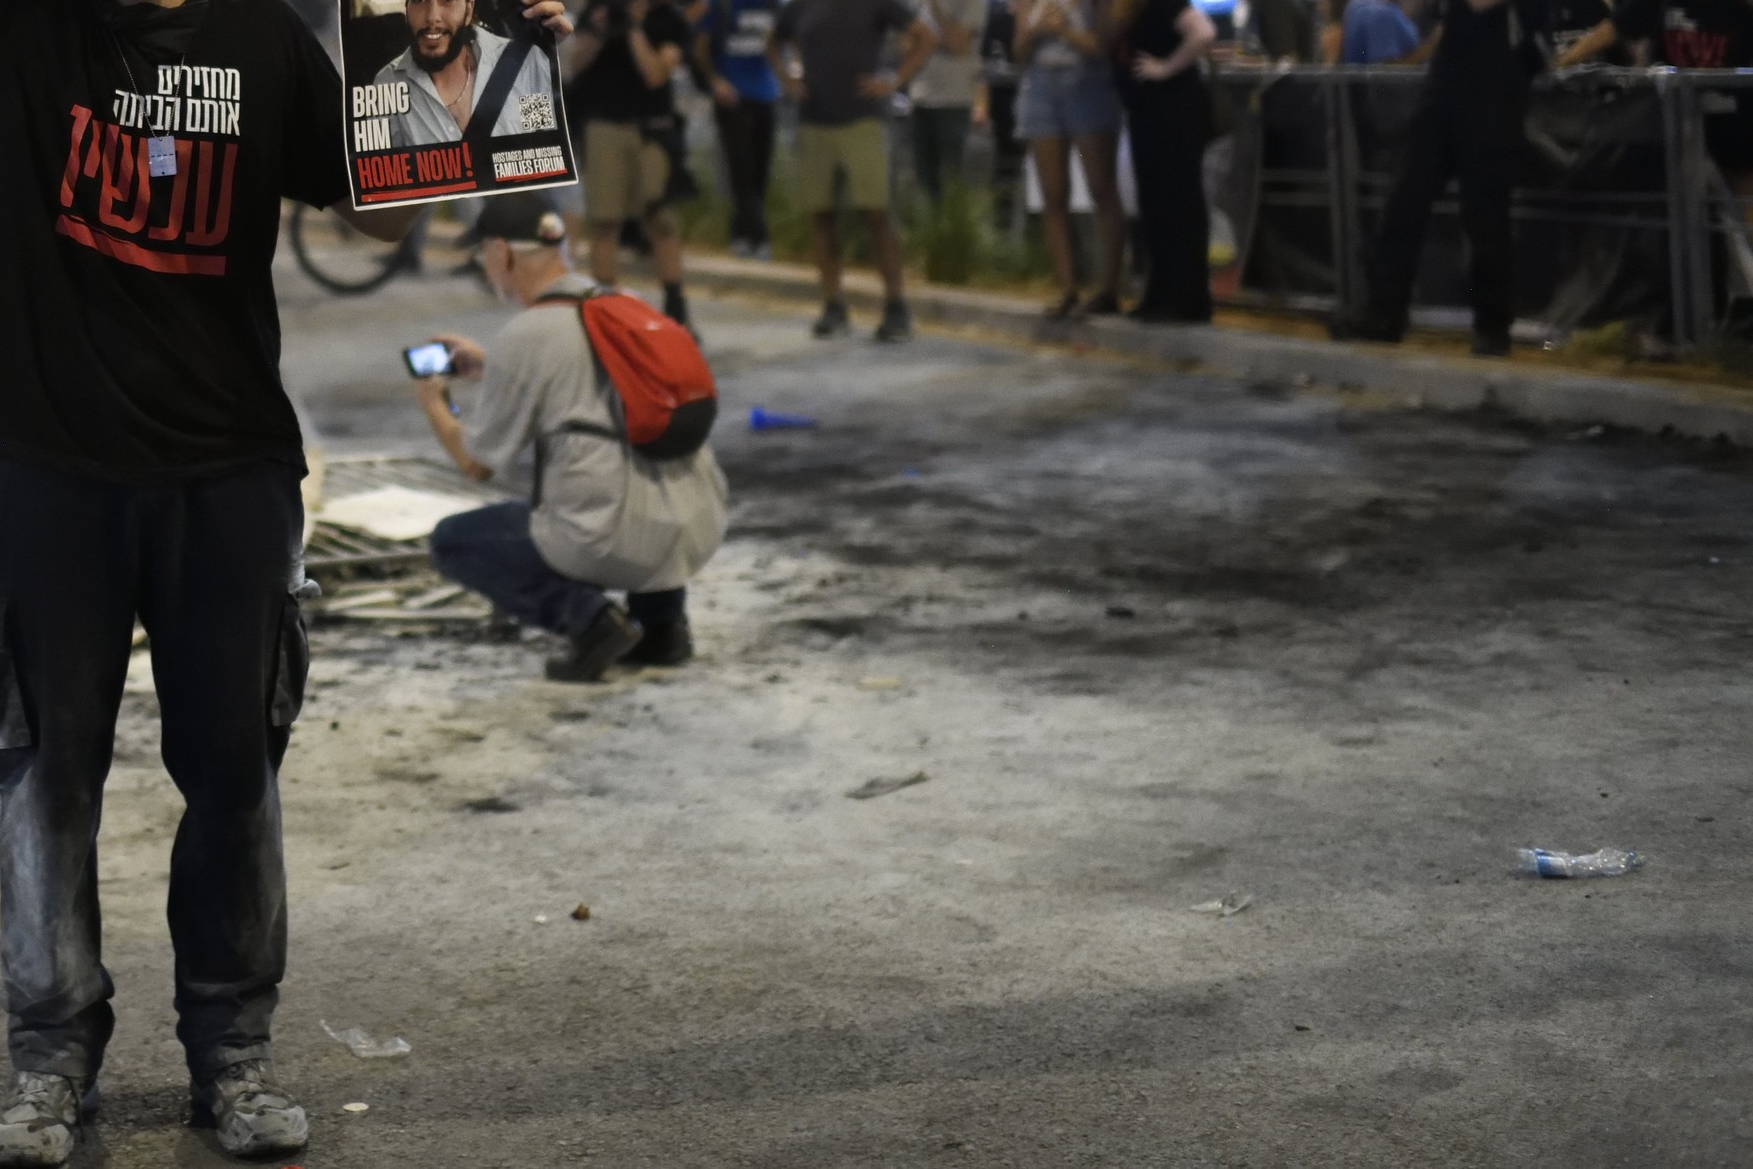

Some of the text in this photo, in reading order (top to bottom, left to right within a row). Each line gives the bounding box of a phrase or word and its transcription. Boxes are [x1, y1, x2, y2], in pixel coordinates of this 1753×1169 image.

[158, 65, 241, 100] מחזירים
[352, 81, 410, 118] BRING
[113, 89, 241, 136] אותם הביתה
[354, 118, 391, 152] HIM
[357, 142, 474, 189] HOME NOW!
[492, 145, 563, 164] HOSTAGES AND MISSING
[494, 156, 566, 178] FAMILIES FORUM
[60, 104, 239, 247] עכשיו
